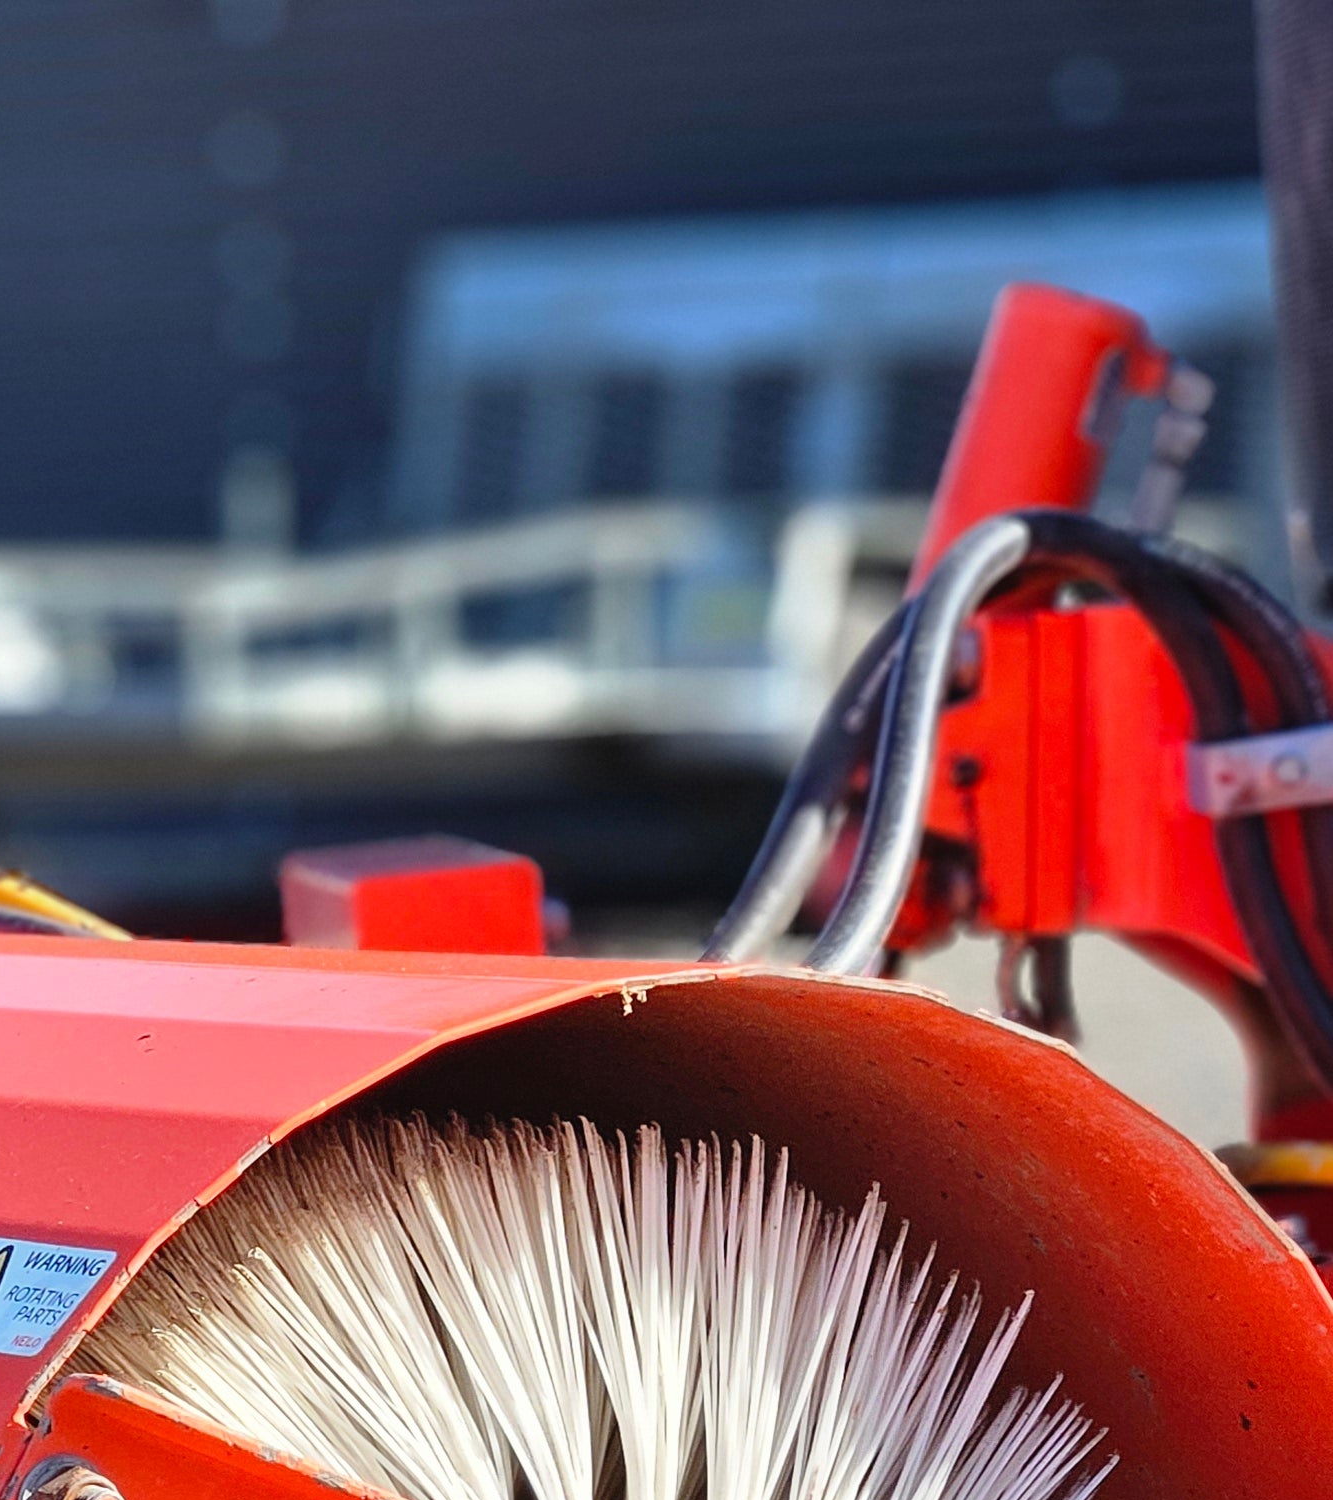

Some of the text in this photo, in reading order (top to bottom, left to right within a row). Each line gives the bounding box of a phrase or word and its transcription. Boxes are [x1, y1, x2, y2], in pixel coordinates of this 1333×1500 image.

[23, 1251, 107, 1277] WARNING
[4, 1285, 79, 1309] ROTATING
[13, 1305, 67, 1327] PARTS!
